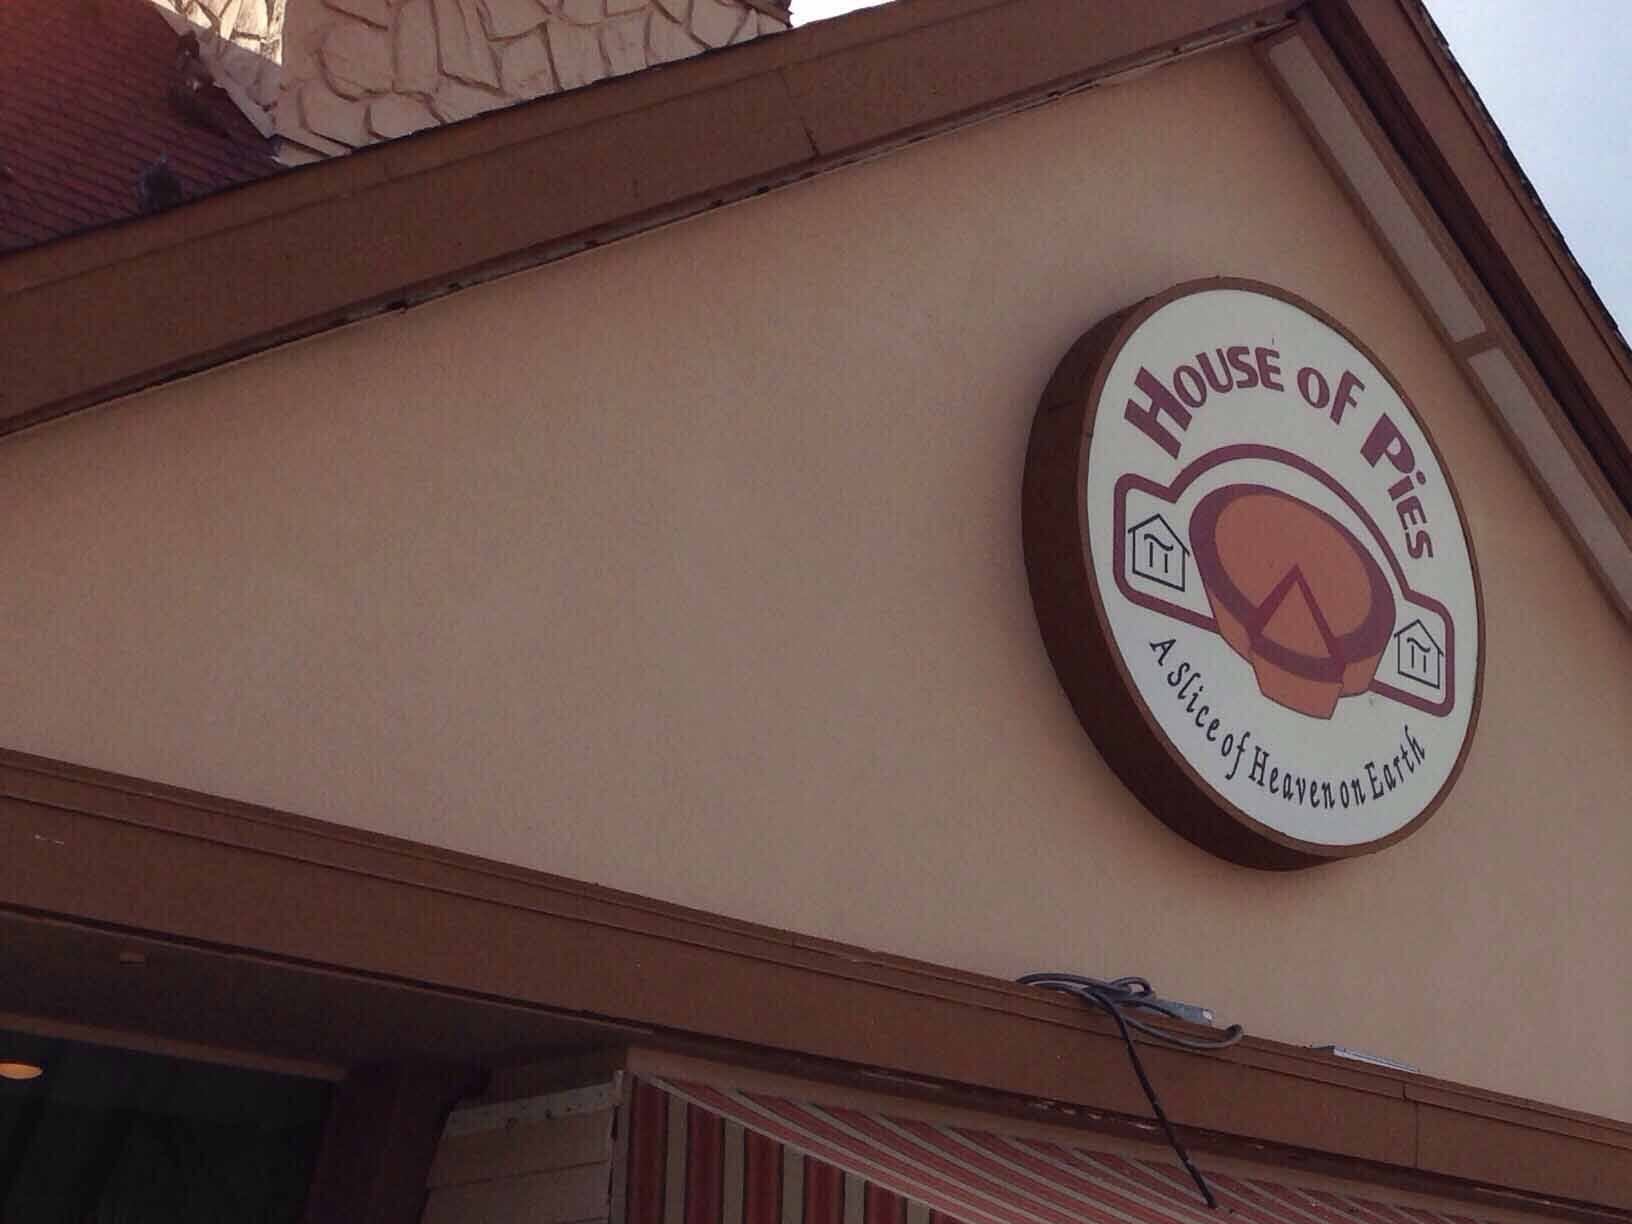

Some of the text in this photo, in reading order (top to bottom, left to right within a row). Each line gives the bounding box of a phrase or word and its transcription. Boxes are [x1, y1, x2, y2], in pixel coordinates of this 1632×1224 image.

[1123, 346, 1285, 460] HOUSE
[1149, 637, 1426, 809] A Slice of Heaven on Earth
